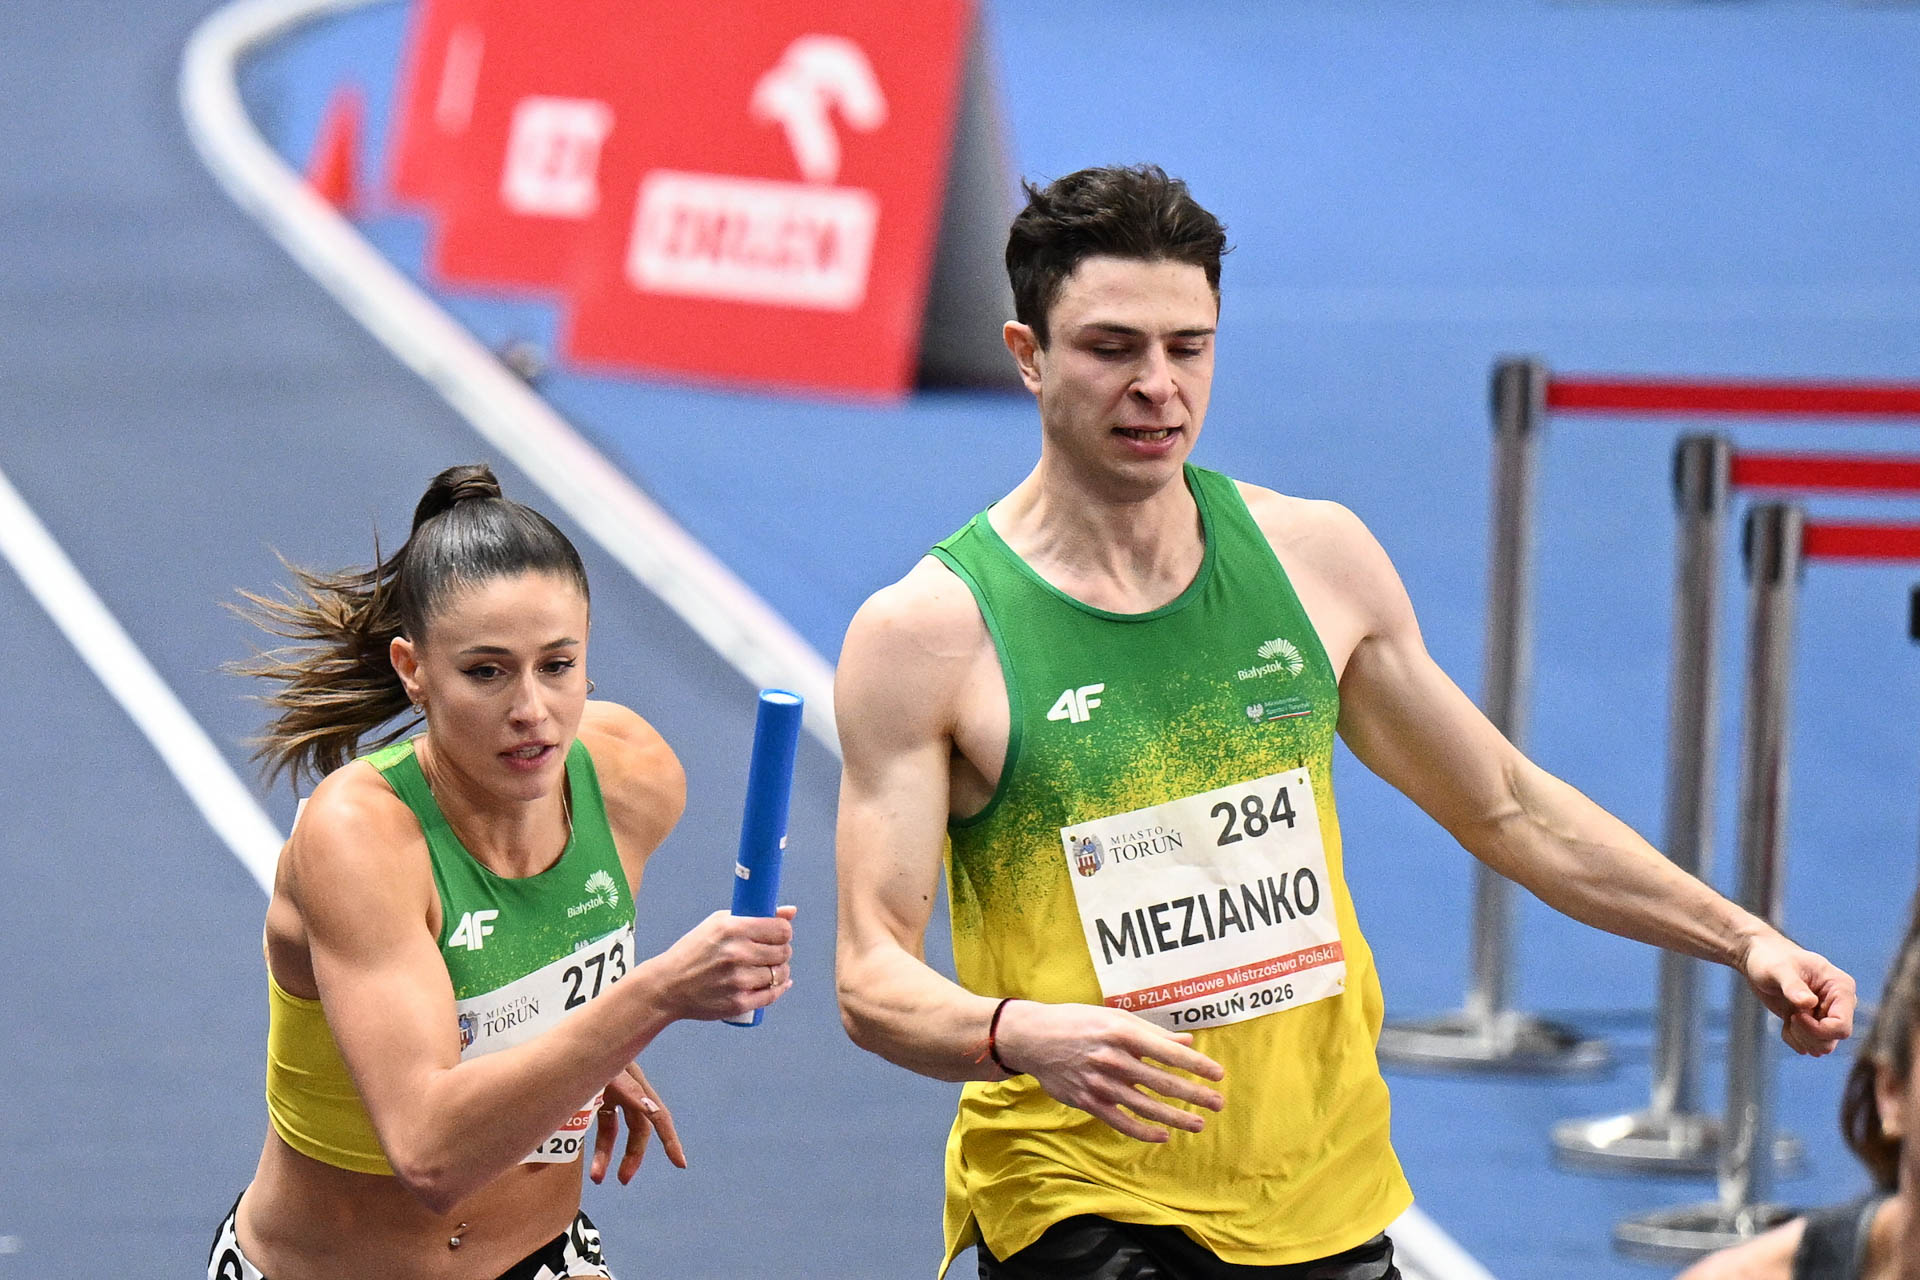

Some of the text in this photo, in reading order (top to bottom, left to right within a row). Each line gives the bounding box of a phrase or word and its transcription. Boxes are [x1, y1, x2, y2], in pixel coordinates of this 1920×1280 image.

[1046, 682, 1105, 724] 4F
[1110, 825, 1163, 845] MIASTO
[1210, 786, 1297, 847] 284
[1109, 828, 1184, 864] TORUŃ
[448, 909, 499, 951] 4F
[1095, 867, 1320, 965] MIEZIANKO
[562, 942, 627, 1011] 273
[1114, 946, 1335, 1010] 70. PZLA Halowe Mistrzostwa Polski
[483, 997, 540, 1037] TORUŃ
[486, 995, 527, 1019] MIASTO
[1169, 983, 1294, 1026] TORUŃ 2026
